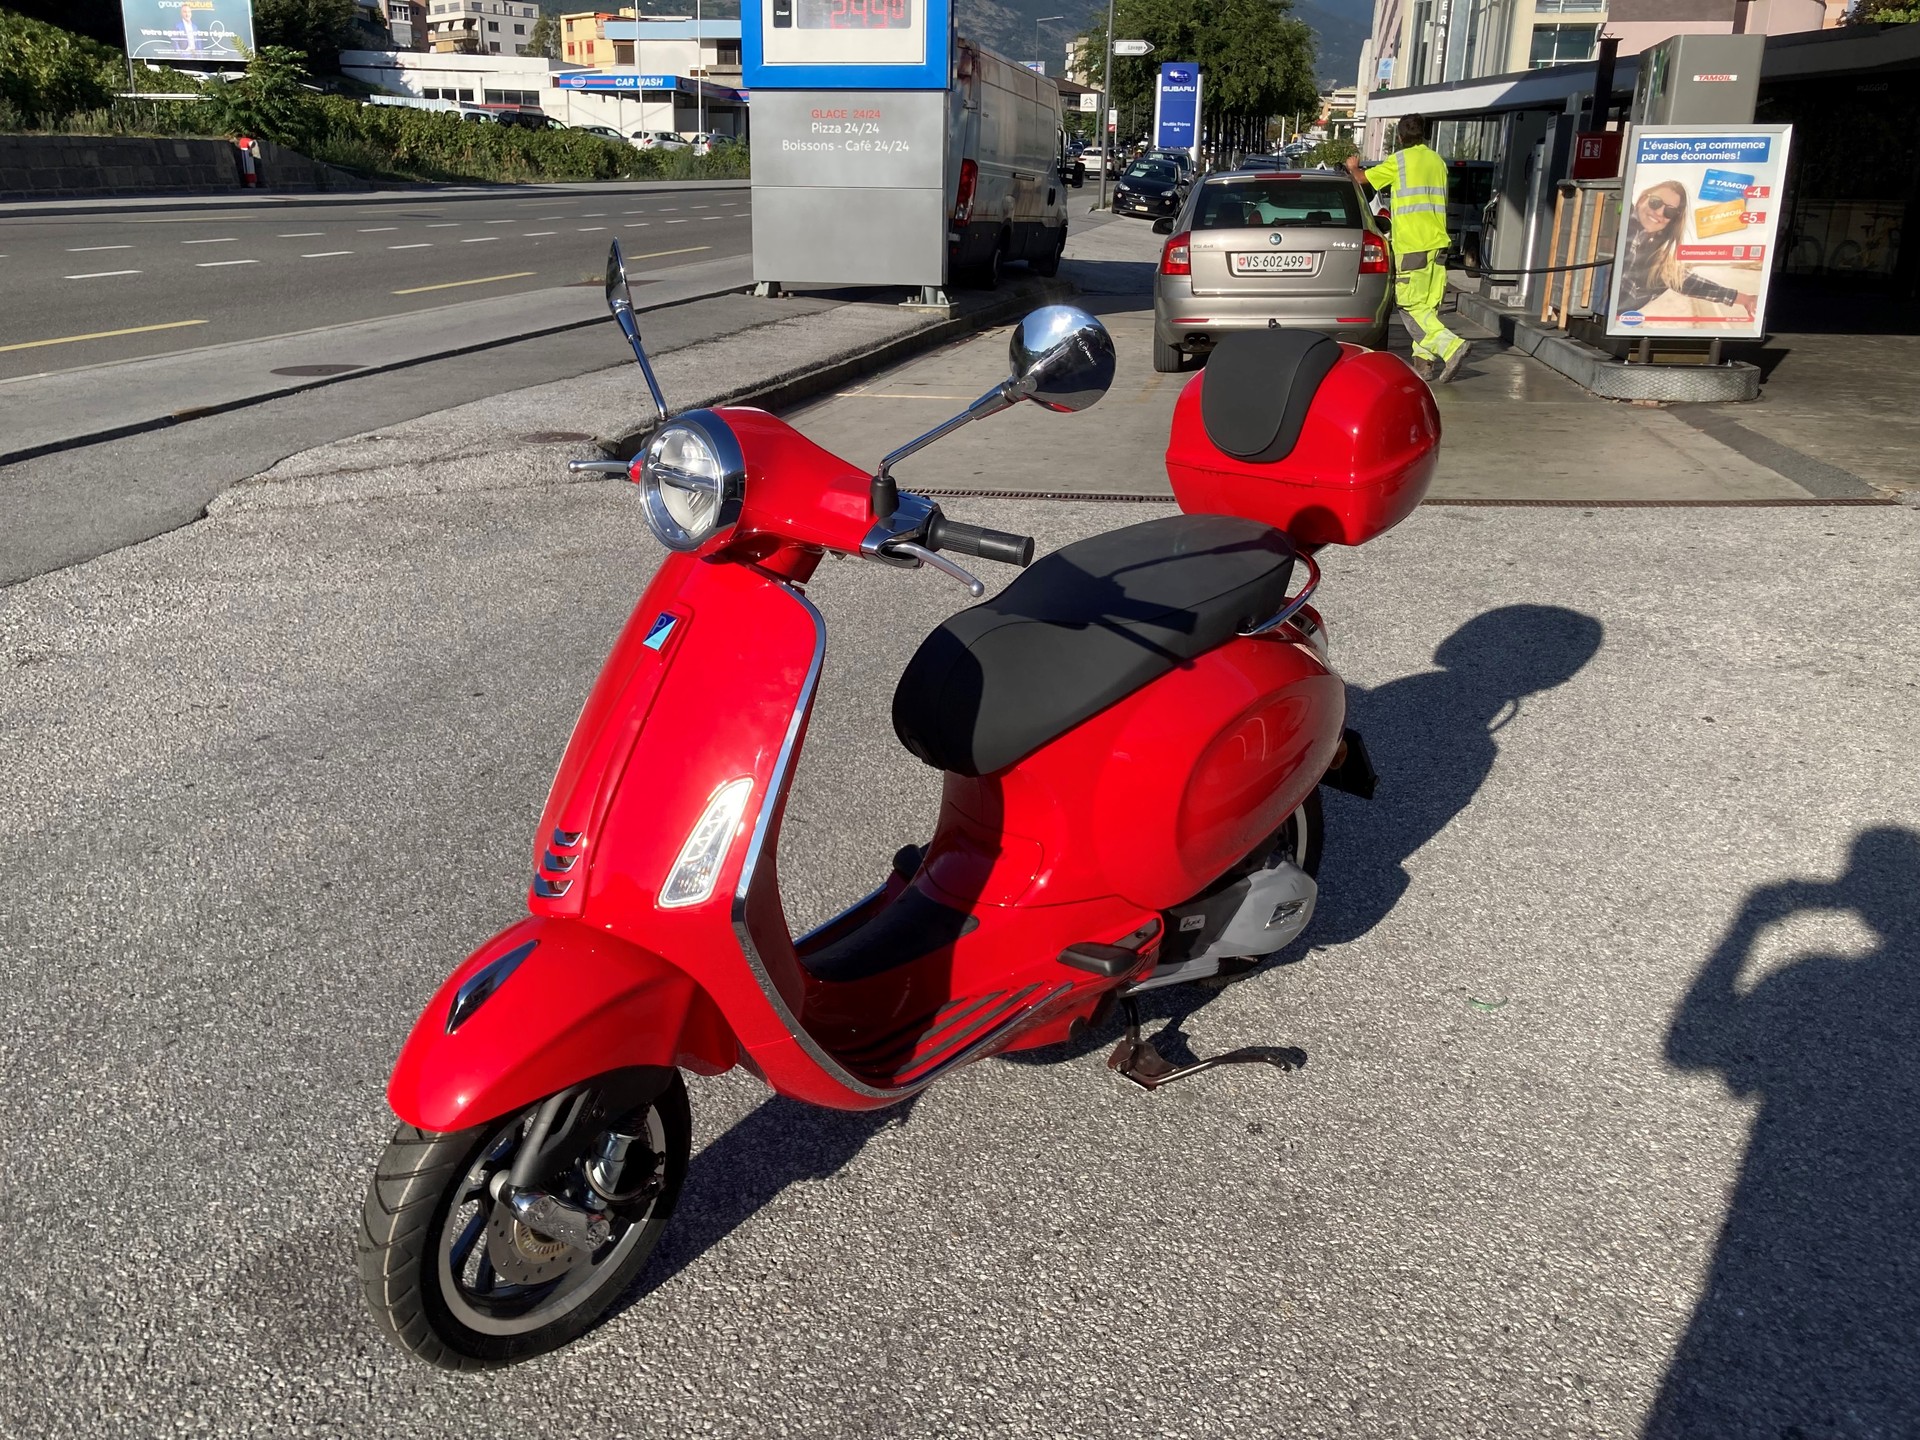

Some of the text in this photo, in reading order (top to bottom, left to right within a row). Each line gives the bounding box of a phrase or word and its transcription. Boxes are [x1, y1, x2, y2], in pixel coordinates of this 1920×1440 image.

[140, 28, 162, 36] Votre
[616, 78, 663, 86] CAR WASH
[811, 109, 881, 119] GLACE 24/24
[811, 122, 880, 136] Pizza 24/24
[782, 139, 835, 151] Boissons
[845, 139, 872, 152] Café
[874, 140, 910, 153] 24/24
[1642, 140, 1766, 152] L'évasion, ça commence
[1641, 153, 1659, 162] par
[1660, 152, 1679, 160] des
[1746, 187, 1761, 198] -4
[1743, 212, 1757, 224] -5
